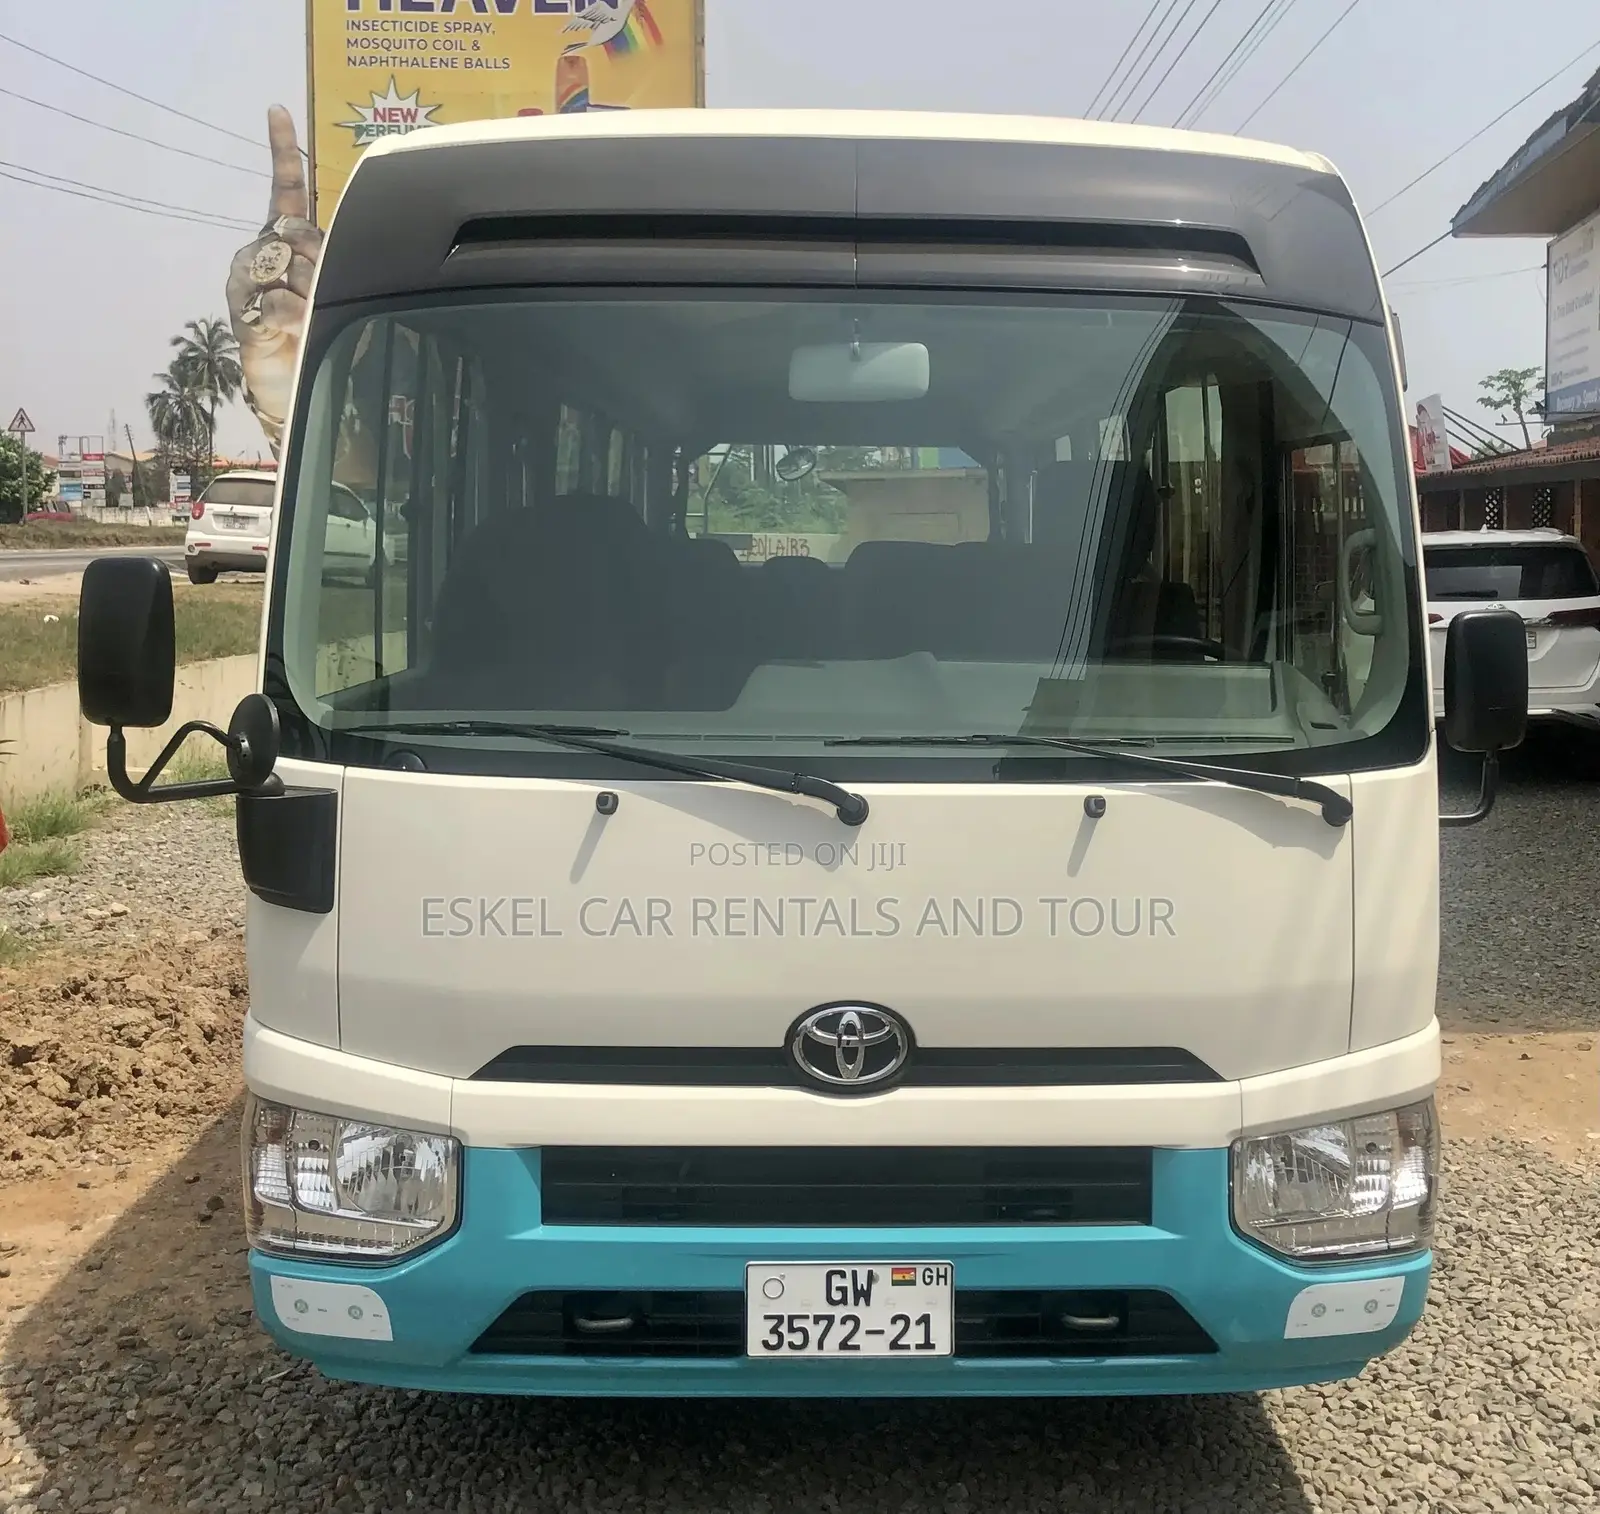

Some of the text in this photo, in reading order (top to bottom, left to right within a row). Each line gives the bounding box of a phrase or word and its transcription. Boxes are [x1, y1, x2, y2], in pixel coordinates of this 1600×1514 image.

[346, 20, 496, 35] INSECTICIDE SPRAY,
[346, 38, 481, 52] MOSQUITO COIL &
[347, 56, 511, 69] NAPHTHALENE BALLS
[373, 108, 419, 123] NEW
[825, 1267, 948, 1307] GW GH
[761, 1313, 936, 1351] 3572-21
